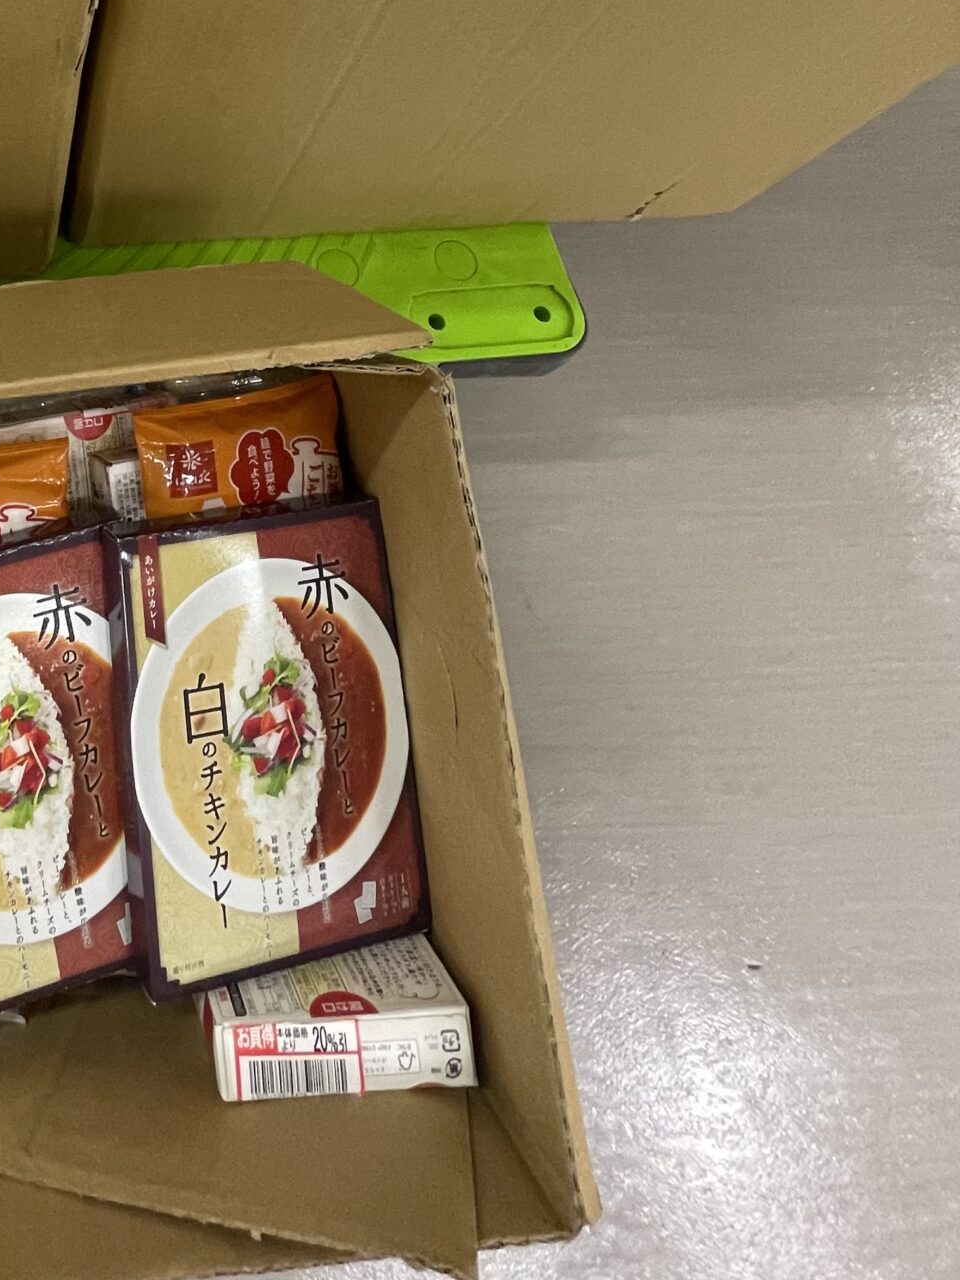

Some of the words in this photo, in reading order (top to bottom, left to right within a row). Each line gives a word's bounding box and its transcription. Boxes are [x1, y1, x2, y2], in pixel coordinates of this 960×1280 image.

[143, 553, 161, 630] あいがけカレー
[32, 583, 111, 840] 赤のビーフカレーと
[296, 552, 355, 816] 赤のビーフカレーと
[182, 671, 234, 930] 白のチキンカレー
[236, 1024, 276, 1049] お買得
[311, 1025, 348, 1053] 20%引
